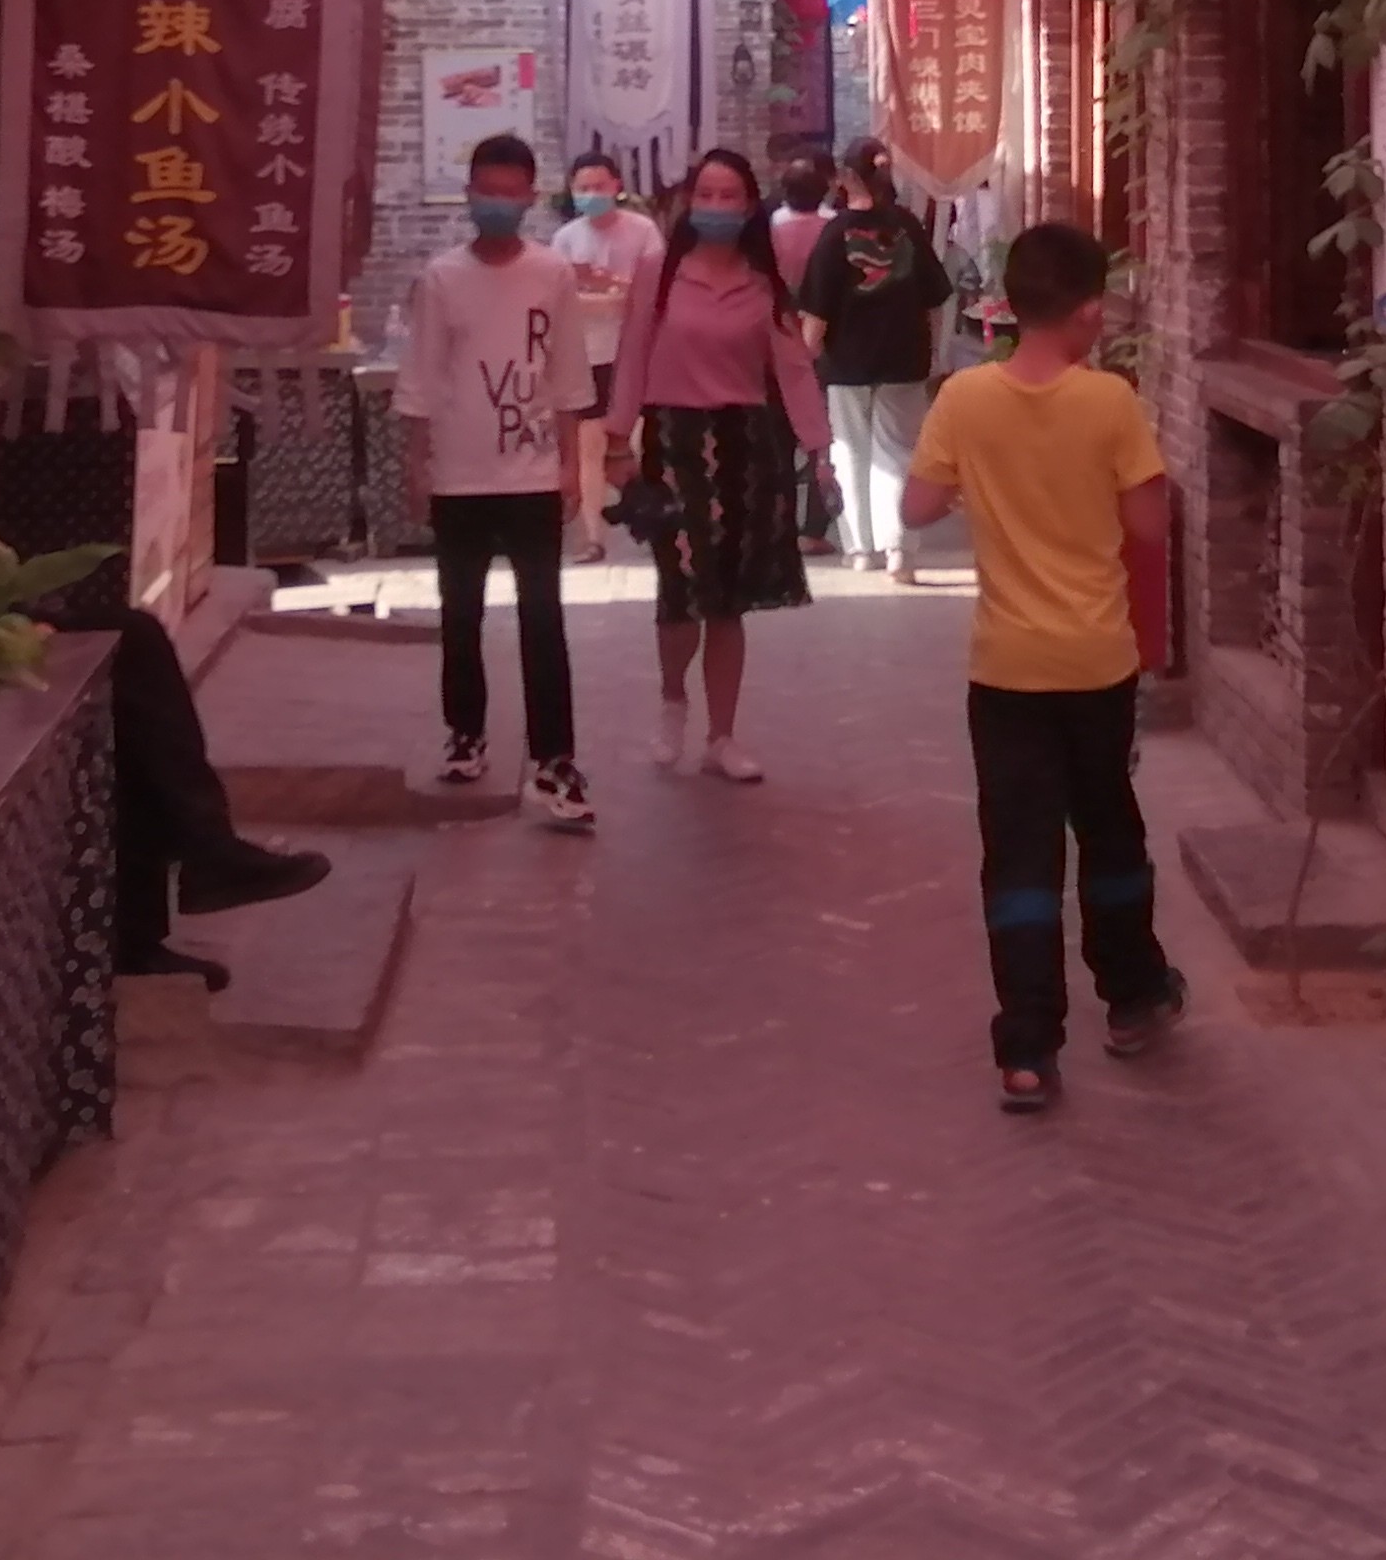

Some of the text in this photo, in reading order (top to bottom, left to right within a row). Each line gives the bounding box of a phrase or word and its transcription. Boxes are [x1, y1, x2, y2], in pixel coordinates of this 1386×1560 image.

[246, 70, 309, 279] 传统小鱼汤
